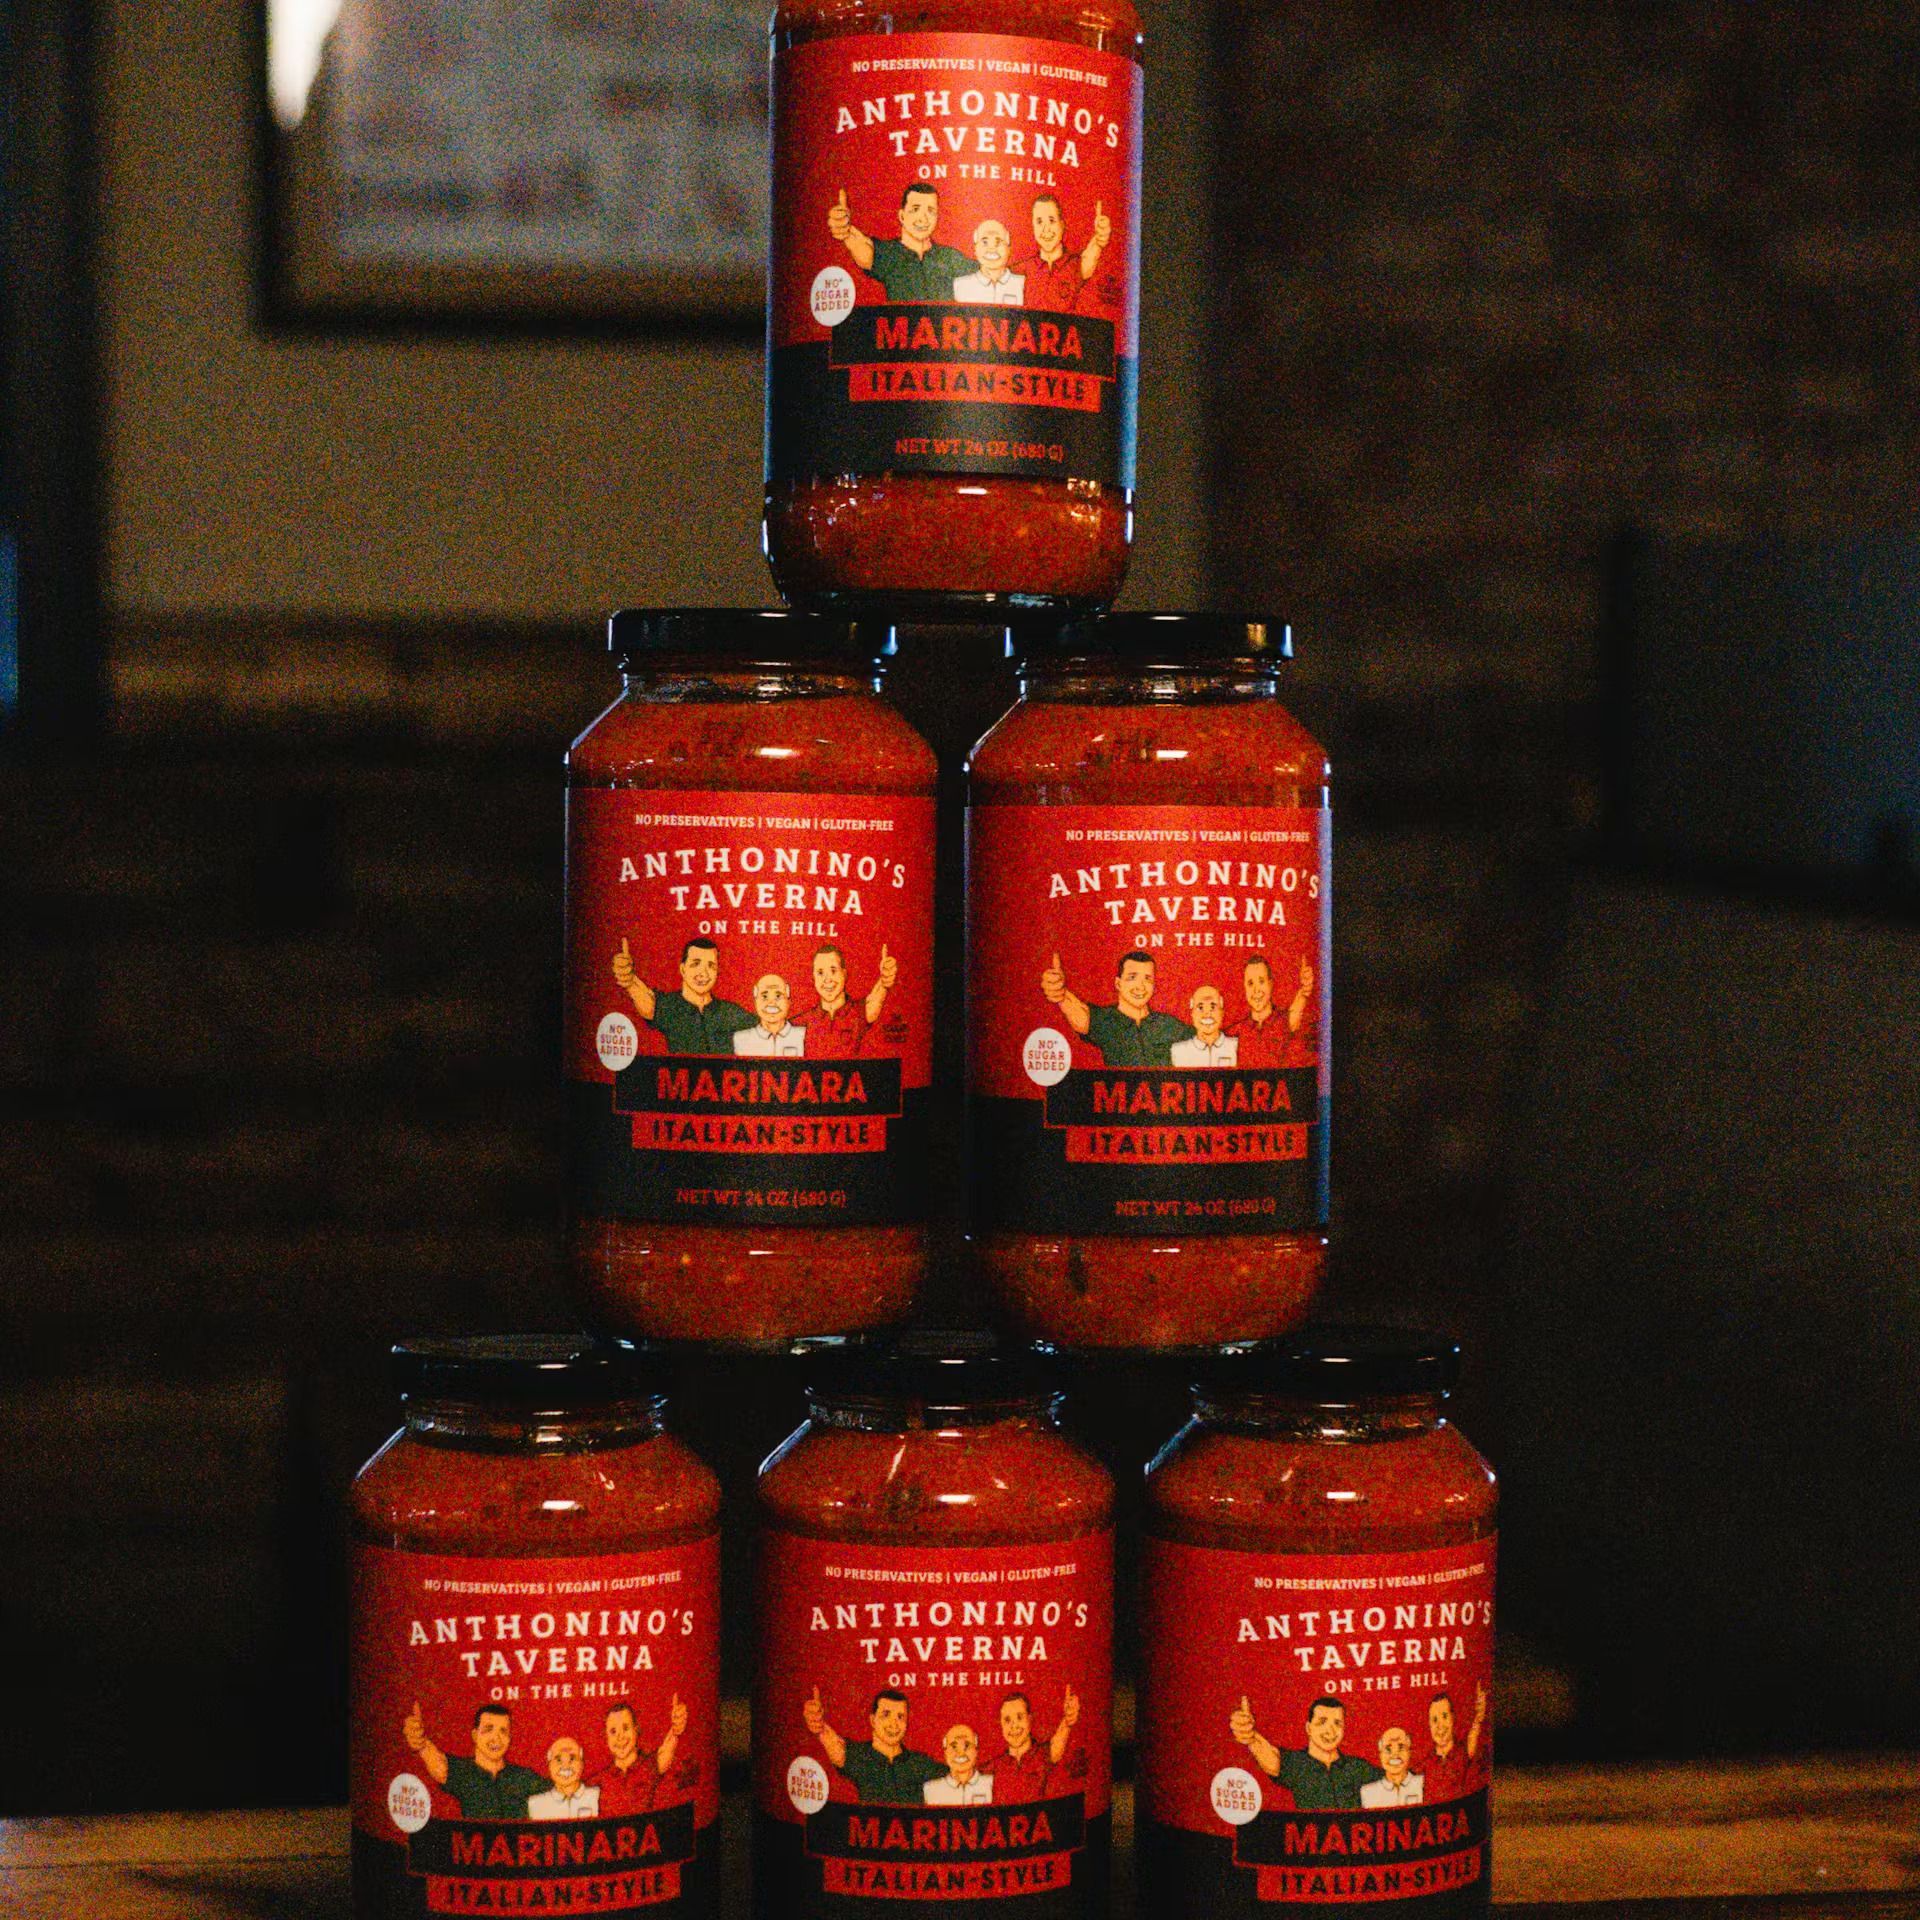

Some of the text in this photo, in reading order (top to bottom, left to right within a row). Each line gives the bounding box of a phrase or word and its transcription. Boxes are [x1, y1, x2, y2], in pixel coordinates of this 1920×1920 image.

[852, 59, 1108, 87] NO PRESERVATIVES VEGAN GLUTEN-FREE
[836, 89, 1119, 148] ANTHONINO'S
[889, 128, 1080, 168] TAVERNA
[918, 165, 1056, 186] ON THE HILL
[814, 300, 849, 312] ADDED
[815, 289, 848, 300] SUGAR
[875, 317, 1083, 359] MARINARA
[871, 366, 1084, 400] ITALIAN-STYLE
[895, 438, 930, 454] NET
[933, 438, 961, 455] WT
[986, 440, 1009, 456] OZ
[635, 814, 894, 831] NO PRESERVATIVES VEGAN GLUTEN-FREE
[1066, 830, 1310, 842] NO PRESERVATIVES VEGAN GLUTEN-FREE
[618, 847, 906, 888] ANTHONINO'S
[1048, 860, 1320, 898] ANTHONINO'S
[670, 884, 864, 915] TAVERNA
[1104, 896, 1287, 926] TAVERNA
[699, 920, 838, 936] ON THE HILL
[1135, 933, 1265, 948] ON THE HILL
[600, 1034, 632, 1046] SUGAR
[600, 1046, 632, 1056] ADDED
[1028, 1050, 1064, 1060] SUGAR
[1028, 1061, 1064, 1070] ADDED
[658, 1068, 867, 1104] MARINARA
[1094, 1080, 1292, 1114] MARINARA
[652, 1119, 869, 1146] ITALIAN-STYLE
[1090, 1128, 1294, 1157] ITALIAN-STYLE
[676, 1188, 710, 1204] NET
[714, 1190, 741, 1206] WT
[766, 1190, 789, 1206] OZ
[1115, 1200, 1150, 1216] NET
[1153, 1201, 1180, 1216] WT
[1205, 1199, 1225, 1215] OZ
[424, 1570, 682, 1594] NO PRESERVATIVES VEGAN GLUTEN-FREE
[826, 1564, 1076, 1584] NO PRESERVATIVES VEGAN GLUTEN-FREE
[1254, 1578, 1272, 1589] NO
[1276, 1578, 1376, 1591] PRESERVATIVES
[1386, 1575, 1426, 1588] VEGAN
[410, 1610, 694, 1646] ANTHONINO'S
[810, 1600, 1088, 1631] ANTHONINO'S
[1237, 1600, 1491, 1643] ANTHONINO'S
[461, 1645, 654, 1678] TAVERNA
[860, 1636, 1047, 1664] TAVERNA
[1294, 1636, 1466, 1672] TAVERNA
[491, 1682, 629, 1701] ON THE HILL
[888, 1672, 1024, 1688] ON THE HILL
[1325, 1672, 1448, 1694] ON THE HILL
[1216, 1788, 1254, 1800] SUGAR
[1216, 1800, 1256, 1810] ADDED
[452, 1824, 662, 1866] MARINARA
[848, 1812, 1053, 1850] MARINARA
[1284, 1809, 1471, 1855] MARINARA
[844, 1860, 1054, 1892] ITALIAN-STYLE
[1281, 1856, 1472, 1894] ITALIAN-STYLE
[449, 1873, 663, 1908] ITALIAN-STYLE
